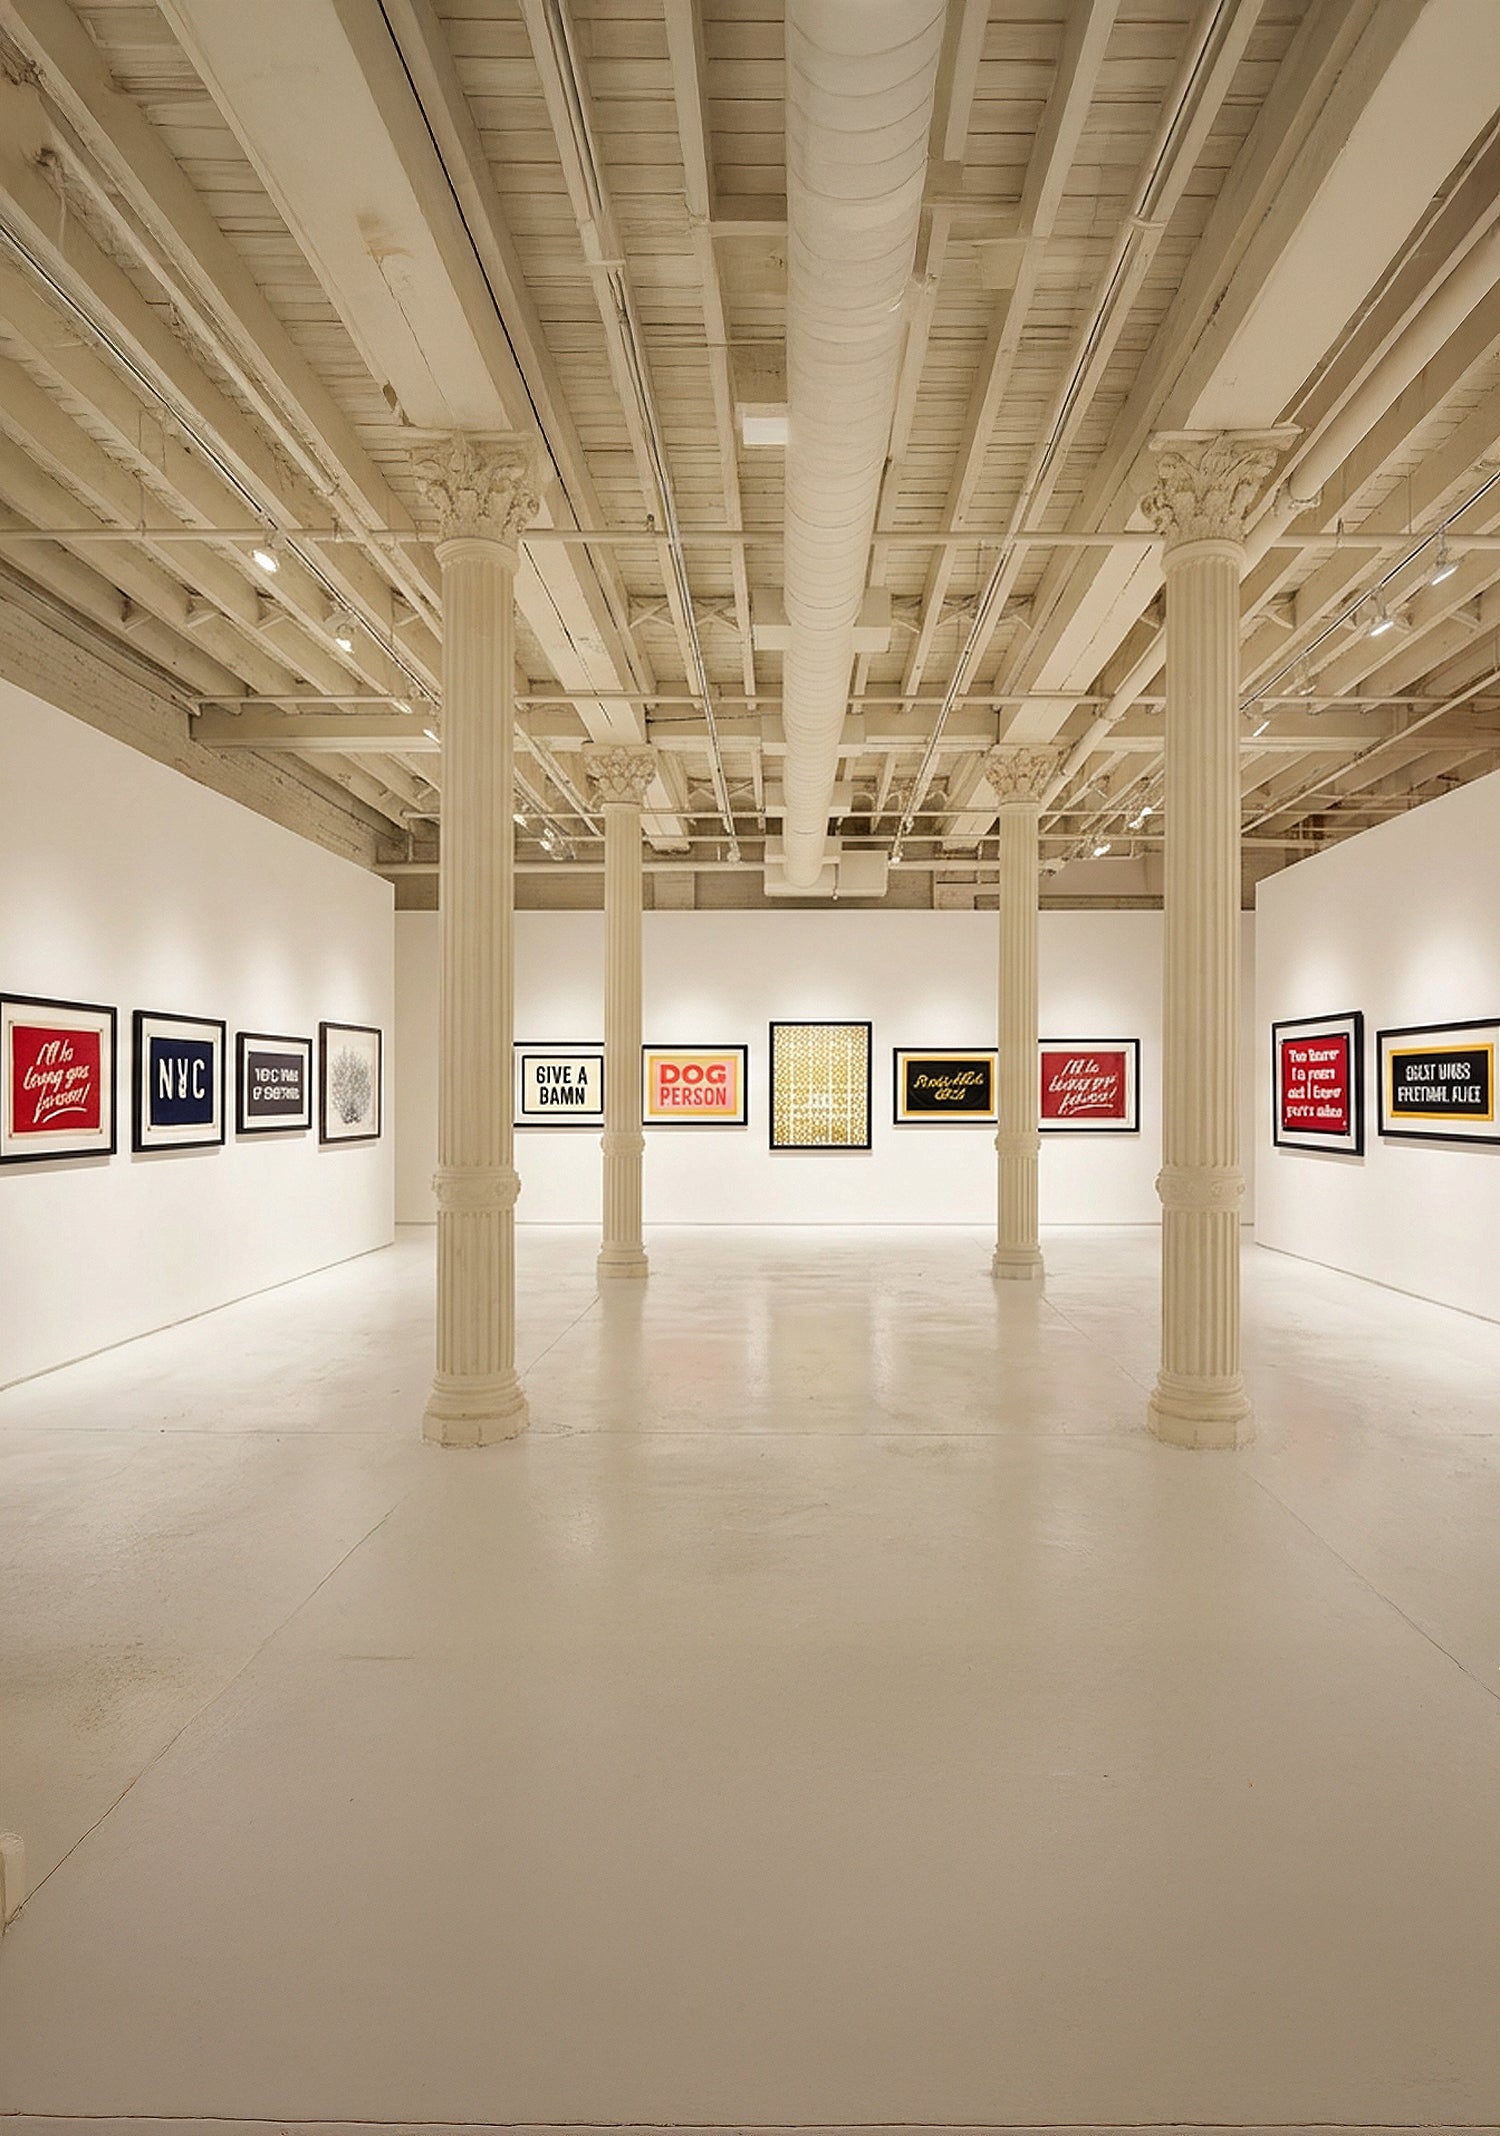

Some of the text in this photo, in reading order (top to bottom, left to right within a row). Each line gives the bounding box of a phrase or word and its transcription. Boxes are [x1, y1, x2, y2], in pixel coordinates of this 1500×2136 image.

[577, 1066, 588, 1085] A
[660, 1064, 727, 1084] DOG
[660, 1087, 727, 1106] PERSON
